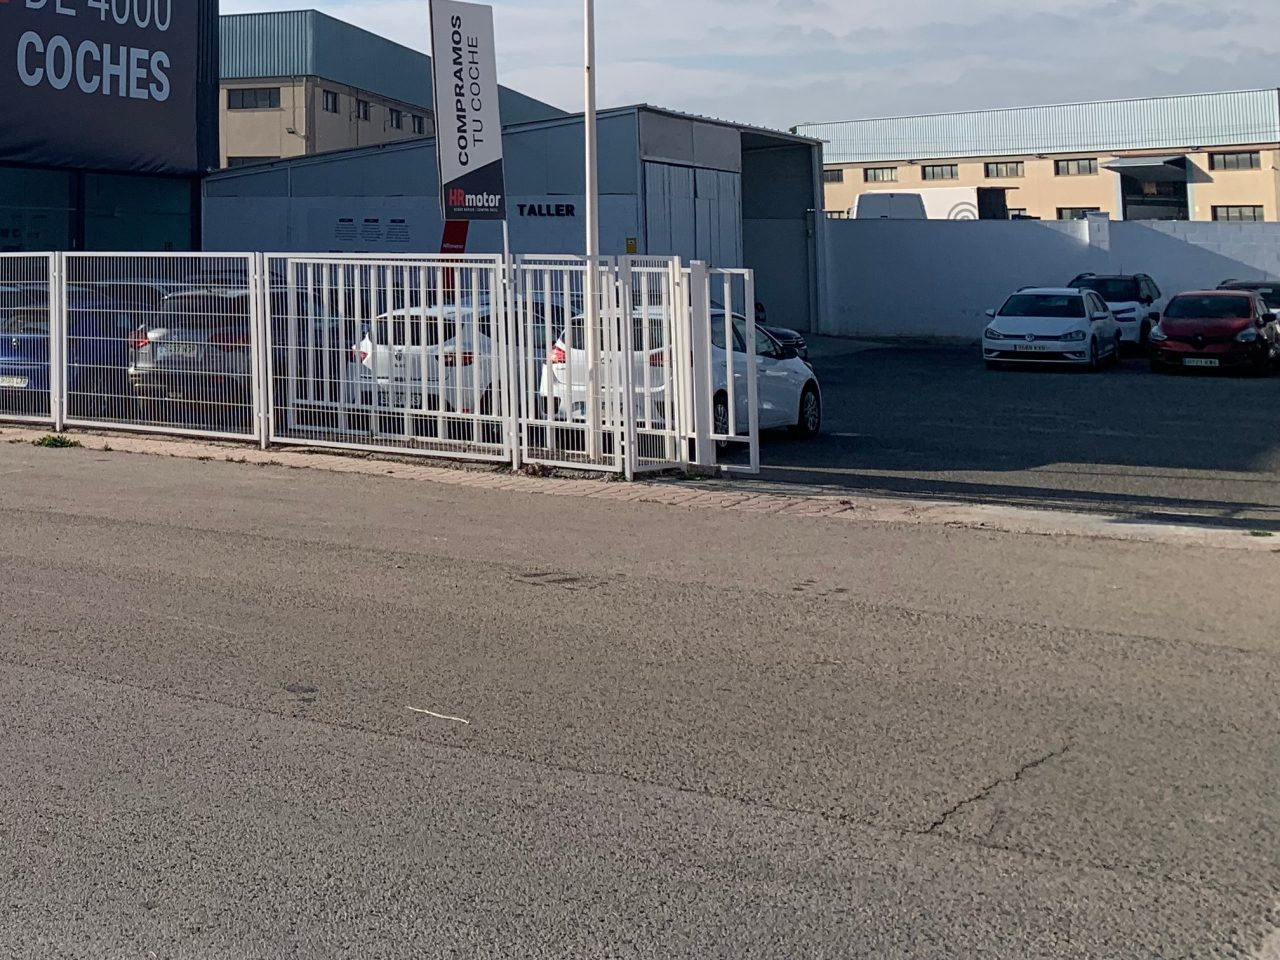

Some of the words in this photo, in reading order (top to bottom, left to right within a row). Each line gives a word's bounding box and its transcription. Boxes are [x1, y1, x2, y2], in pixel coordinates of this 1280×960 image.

[17, 30, 171, 102] COCHES
[451, 14, 469, 166] COMPRAMOS
[467, 36, 482, 112] COCHE
[473, 119, 484, 147] TU
[449, 189, 501, 207] HRmotor
[517, 204, 575, 217] TALLER
